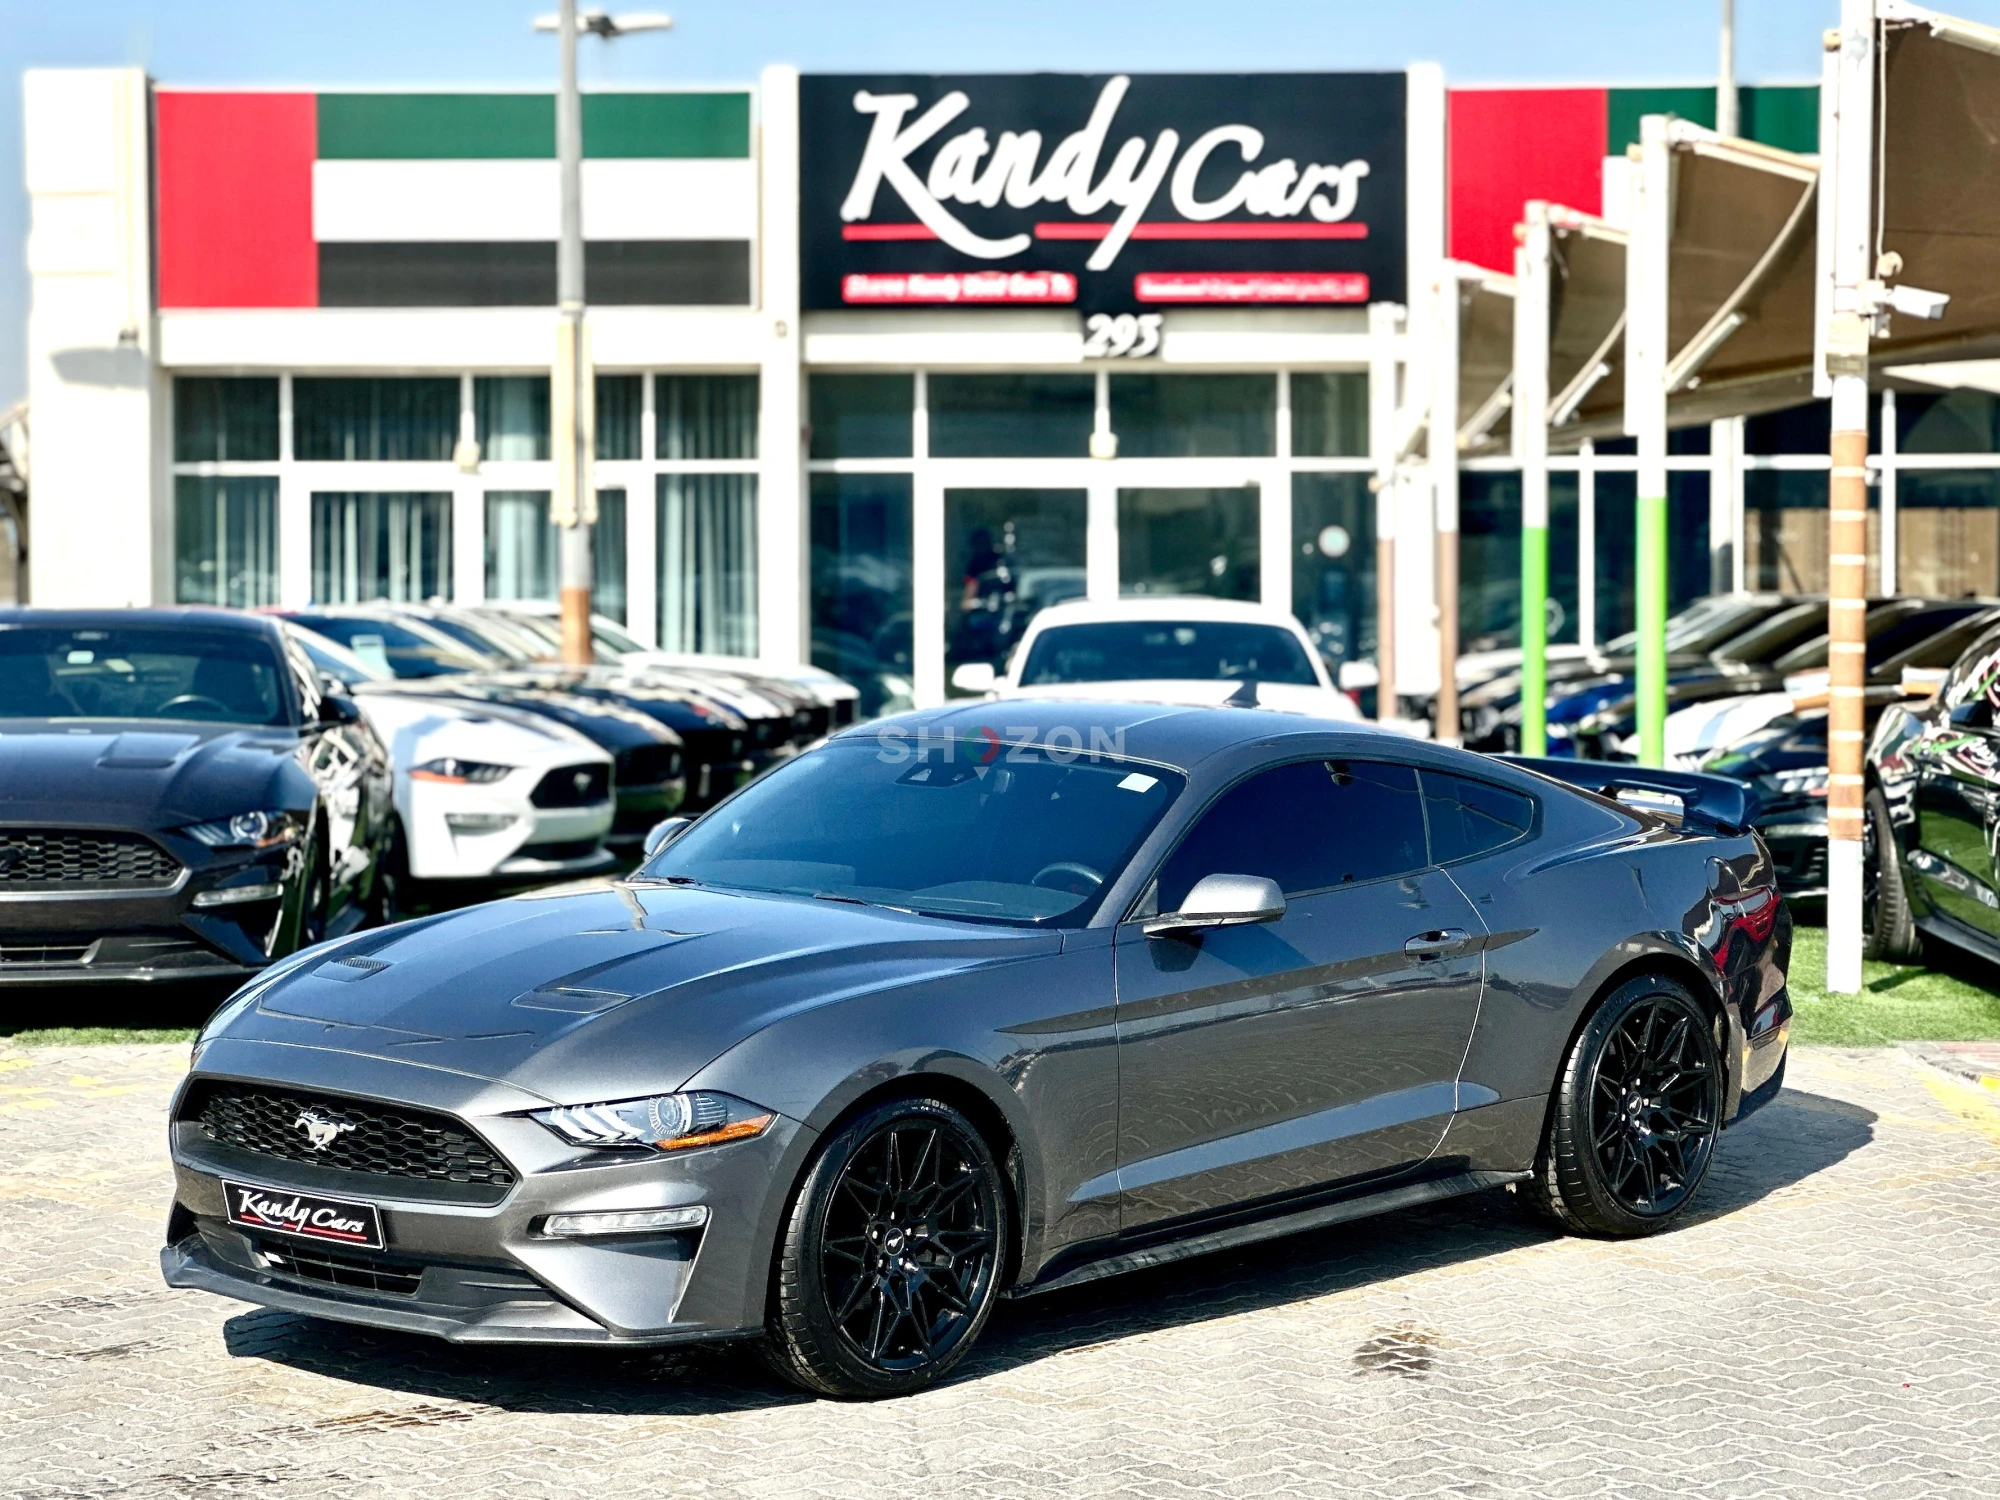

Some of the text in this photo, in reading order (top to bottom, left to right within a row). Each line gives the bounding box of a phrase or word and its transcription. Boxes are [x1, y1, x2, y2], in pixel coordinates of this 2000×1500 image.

[841, 75, 1370, 271] Kandy Cars
[1083, 313, 1163, 358] 295
[238, 1189, 365, 1233] Kandy Cars
